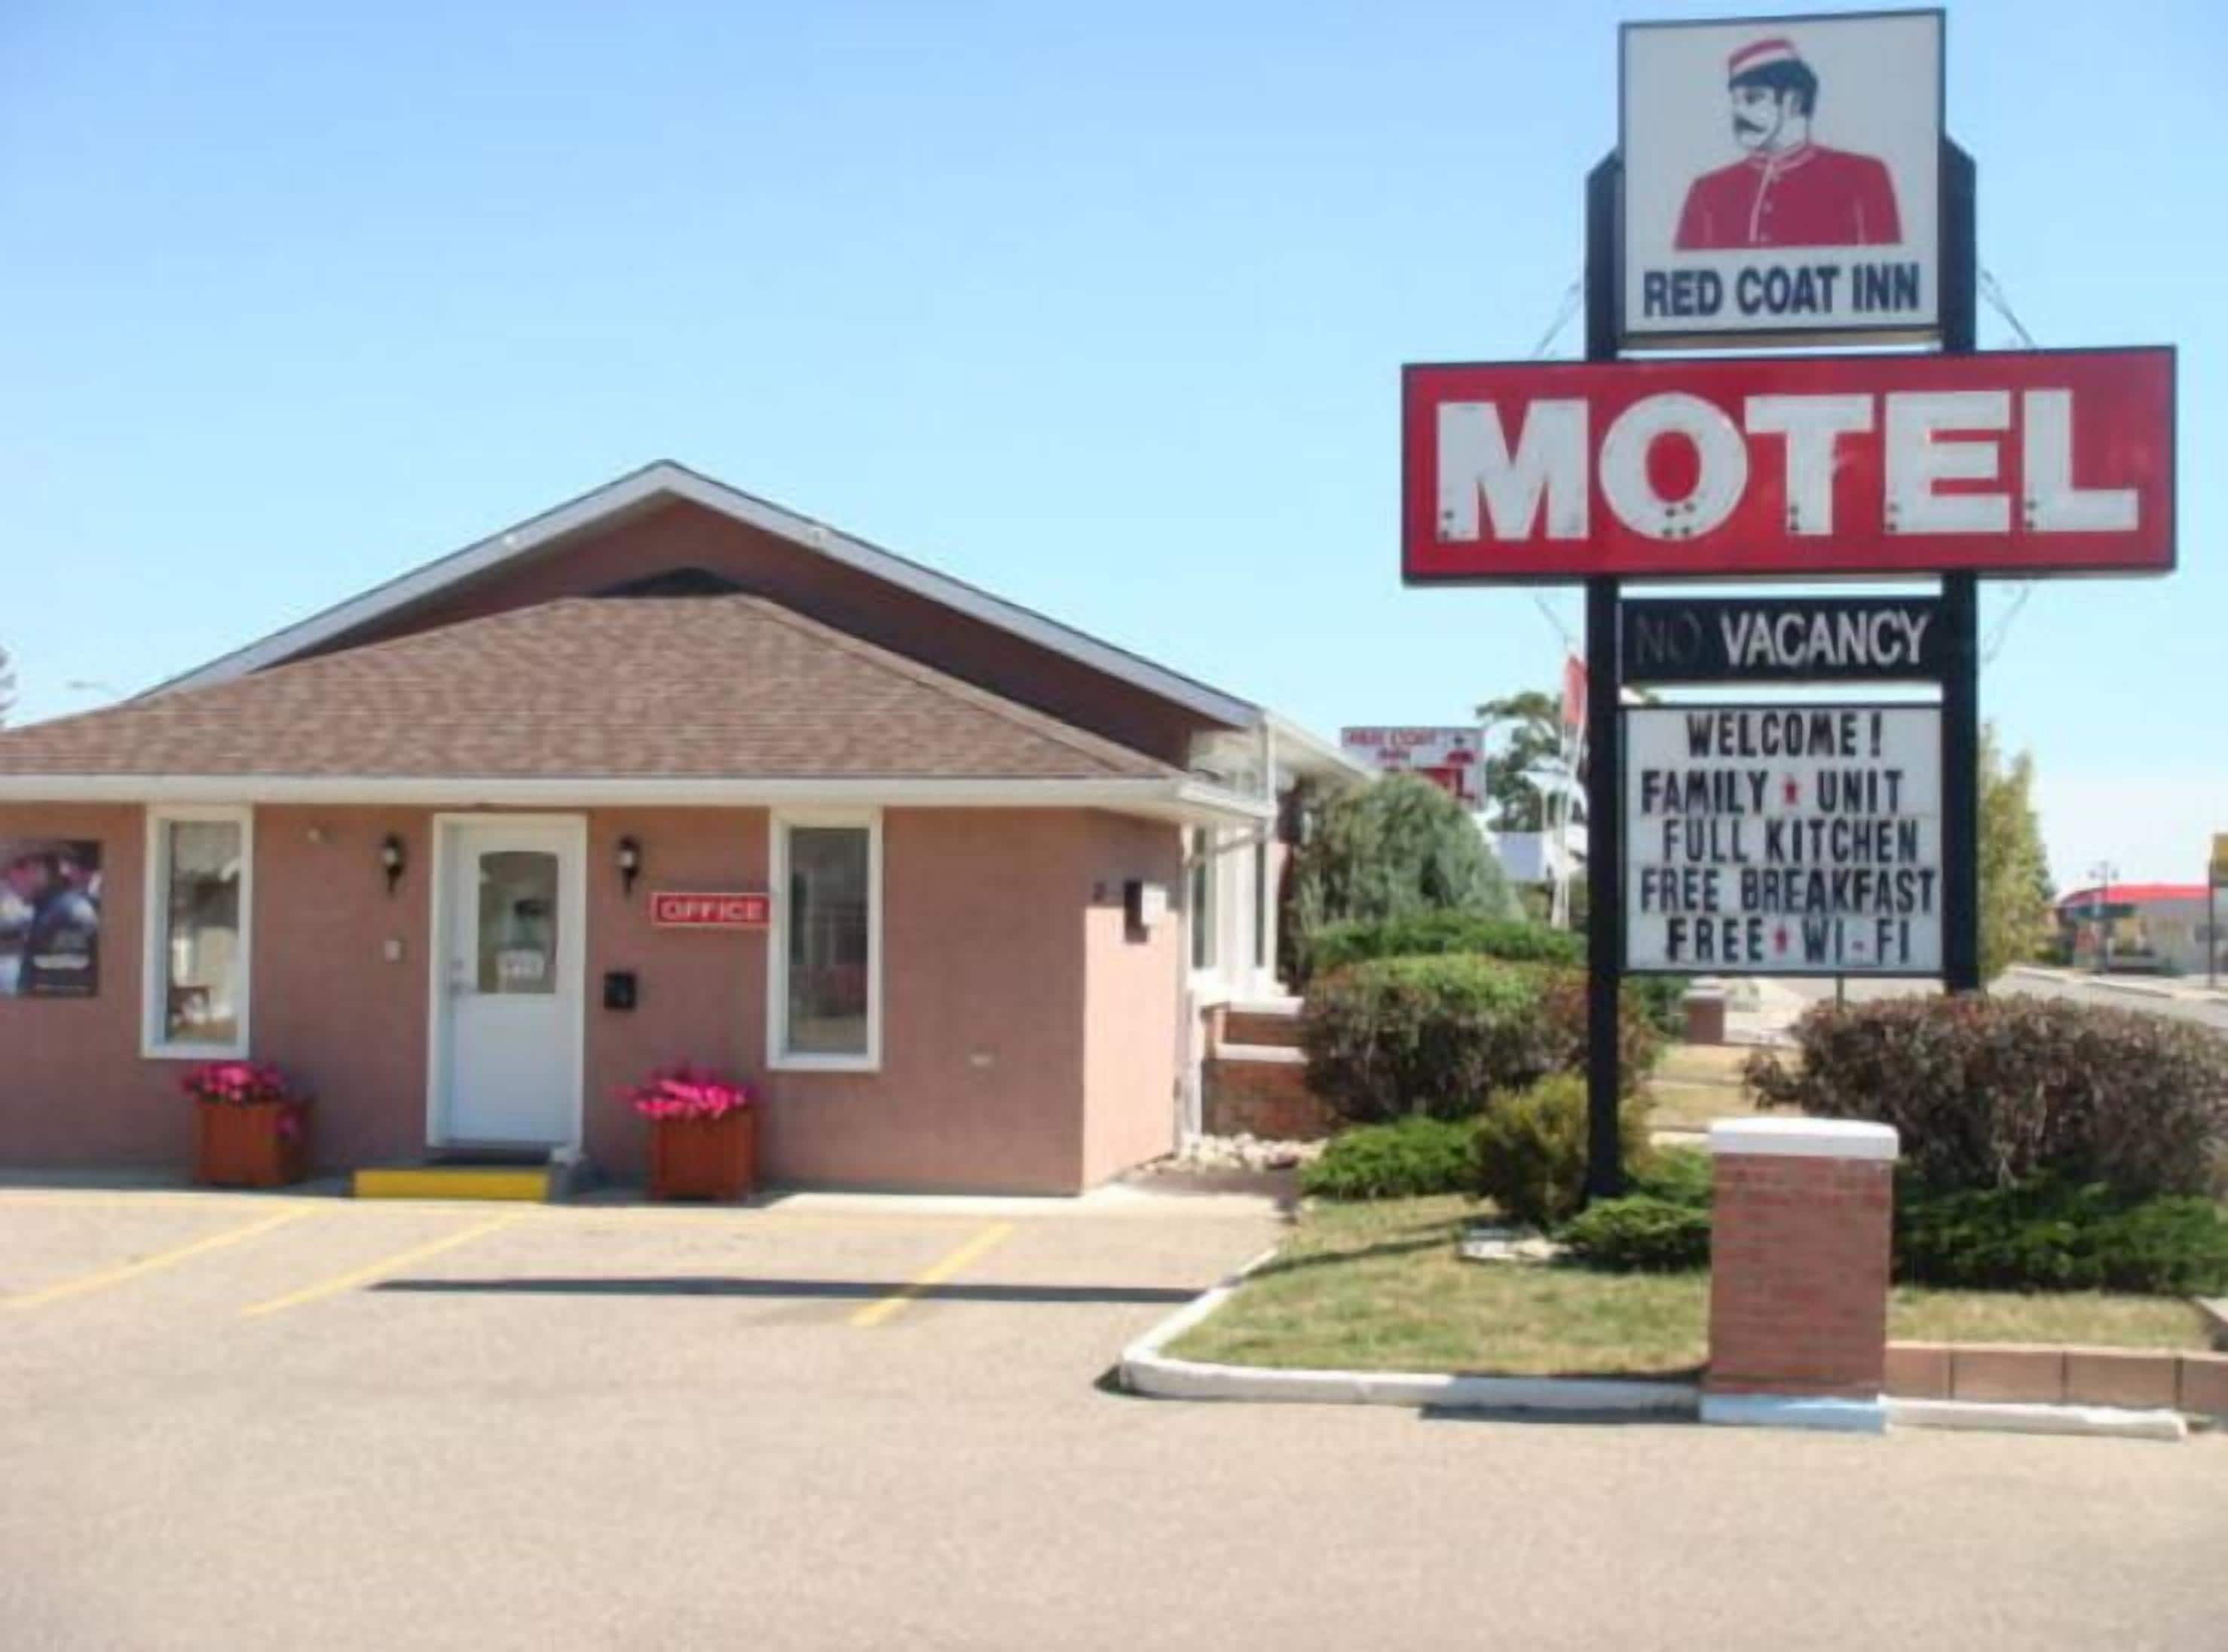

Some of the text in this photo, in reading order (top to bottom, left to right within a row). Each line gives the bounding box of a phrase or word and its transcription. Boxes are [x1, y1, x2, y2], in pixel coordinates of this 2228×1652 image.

[1643, 262, 1920, 317] RED COAT INN
[1436, 389, 2140, 542] MOTEL
[1636, 608, 1932, 666] NO VACANCY
[1686, 712, 1883, 757] WELCOME!
[1641, 769, 1903, 814] FAMILY UNIT
[1662, 818, 1918, 864] FULL KITCHEN
[660, 901, 764, 920] OFFICE
[1640, 867, 1936, 914] FREE BREAKFAST
[1666, 917, 1911, 965] FREE WI-FI
